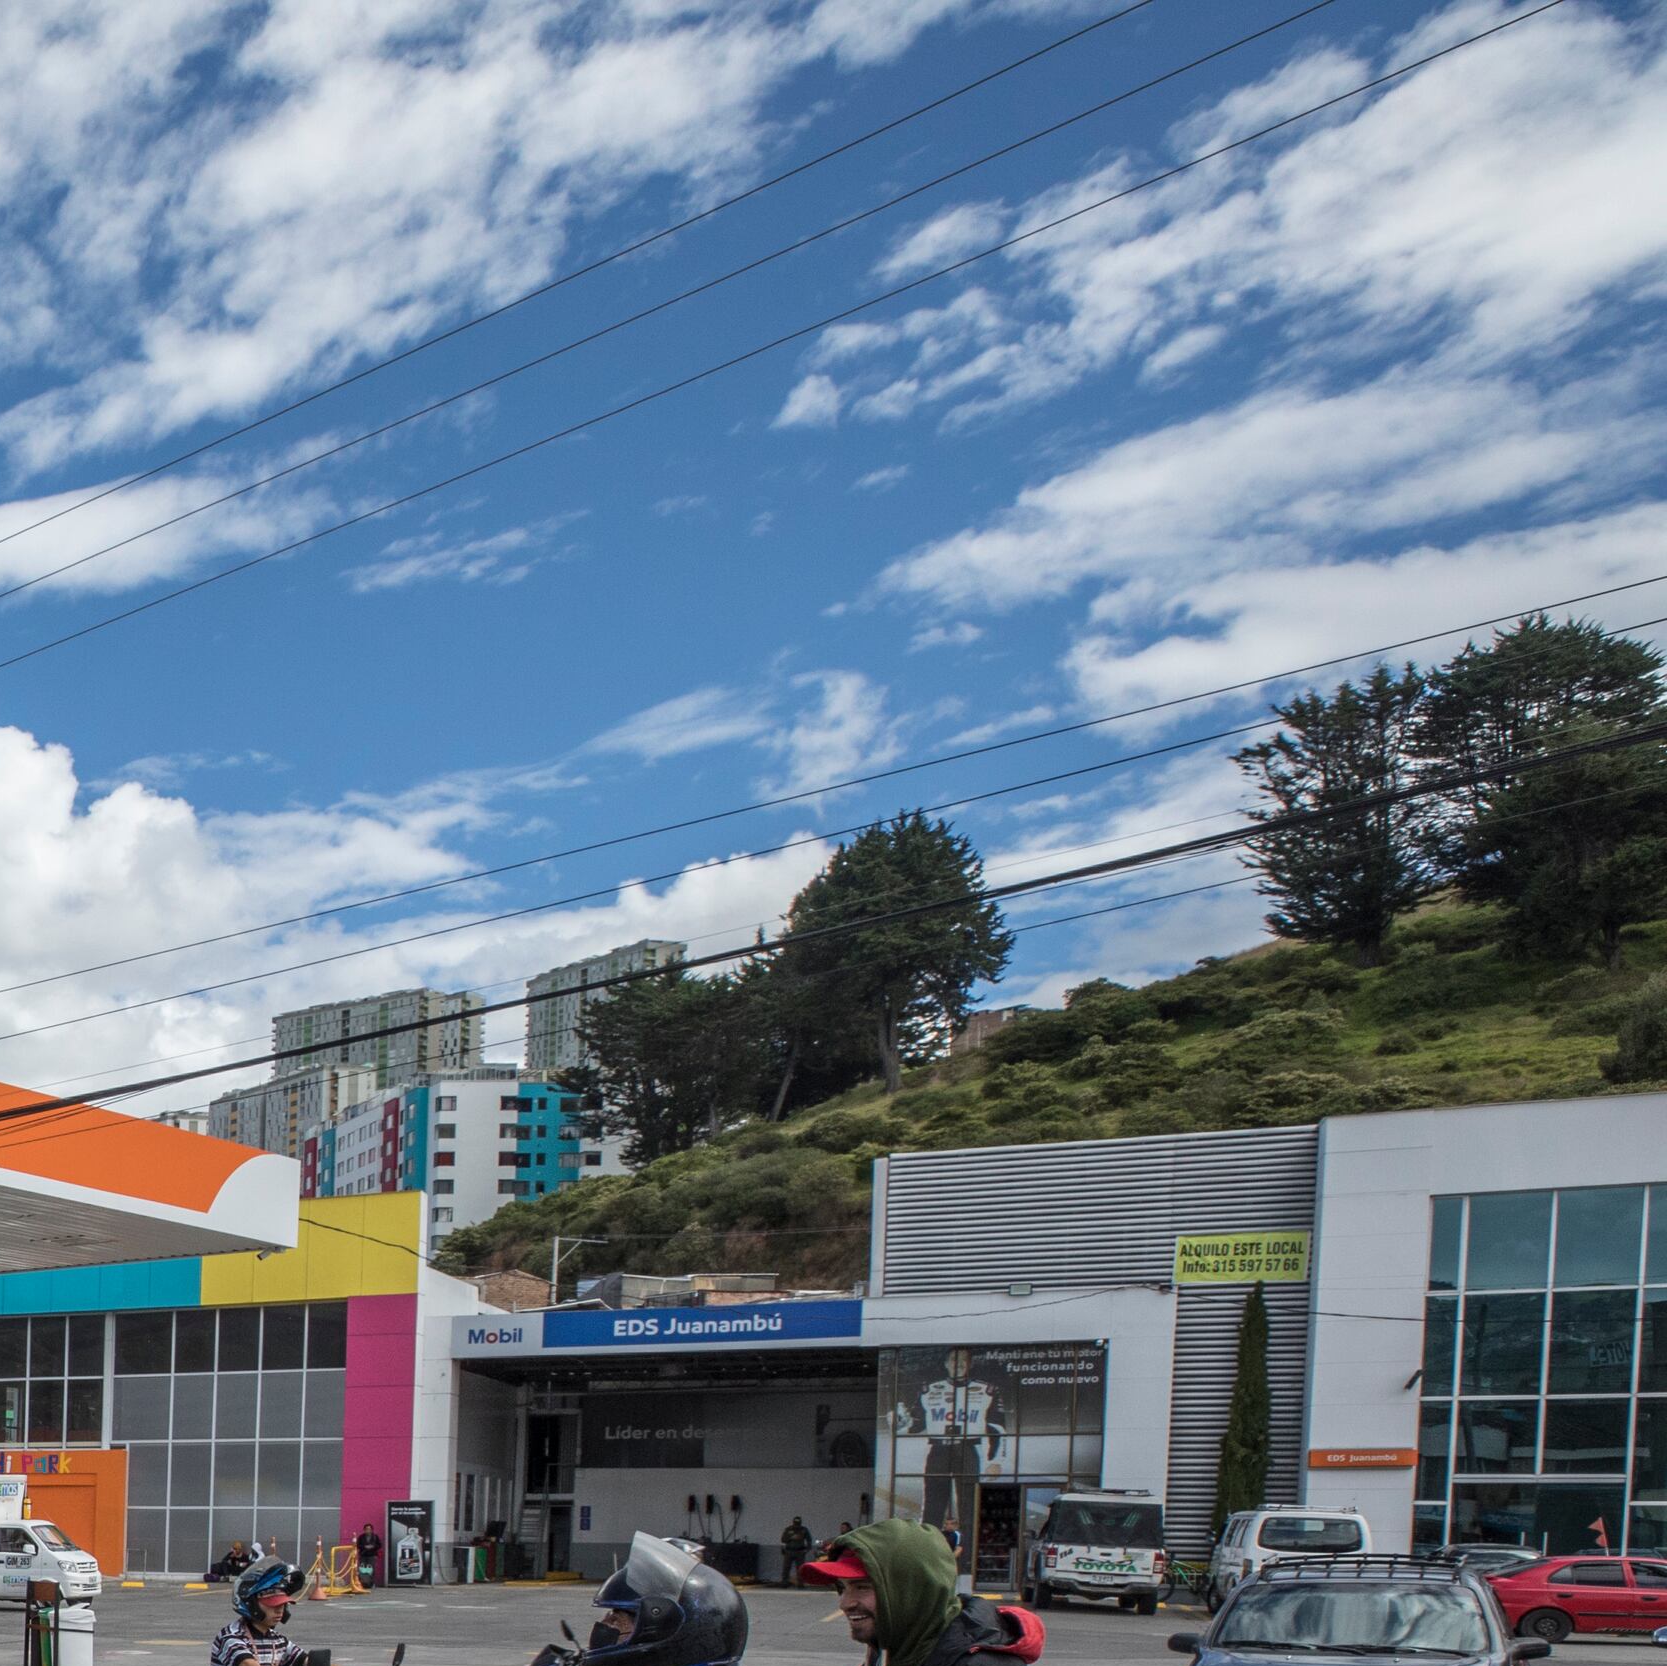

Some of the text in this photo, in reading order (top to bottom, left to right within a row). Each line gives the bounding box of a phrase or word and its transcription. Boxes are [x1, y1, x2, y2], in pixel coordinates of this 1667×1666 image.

[1179, 1241, 1304, 1257] ALQUILO ESTE LOCAL
[1183, 1258, 1300, 1273] Info: 315 597 57 66
[613, 1313, 783, 1337] EDS Juanambú
[468, 1328, 523, 1344] Mobil
[1006, 1363, 1094, 1373] funcionando
[1021, 1375, 1099, 1385] como nuevo
[931, 1408, 979, 1423] Mobil
[604, 1424, 651, 1440] Líder
[655, 1428, 678, 1439] en
[1327, 1454, 1346, 1462] EDS
[1072, 1560, 1137, 1573] TOYOTA
